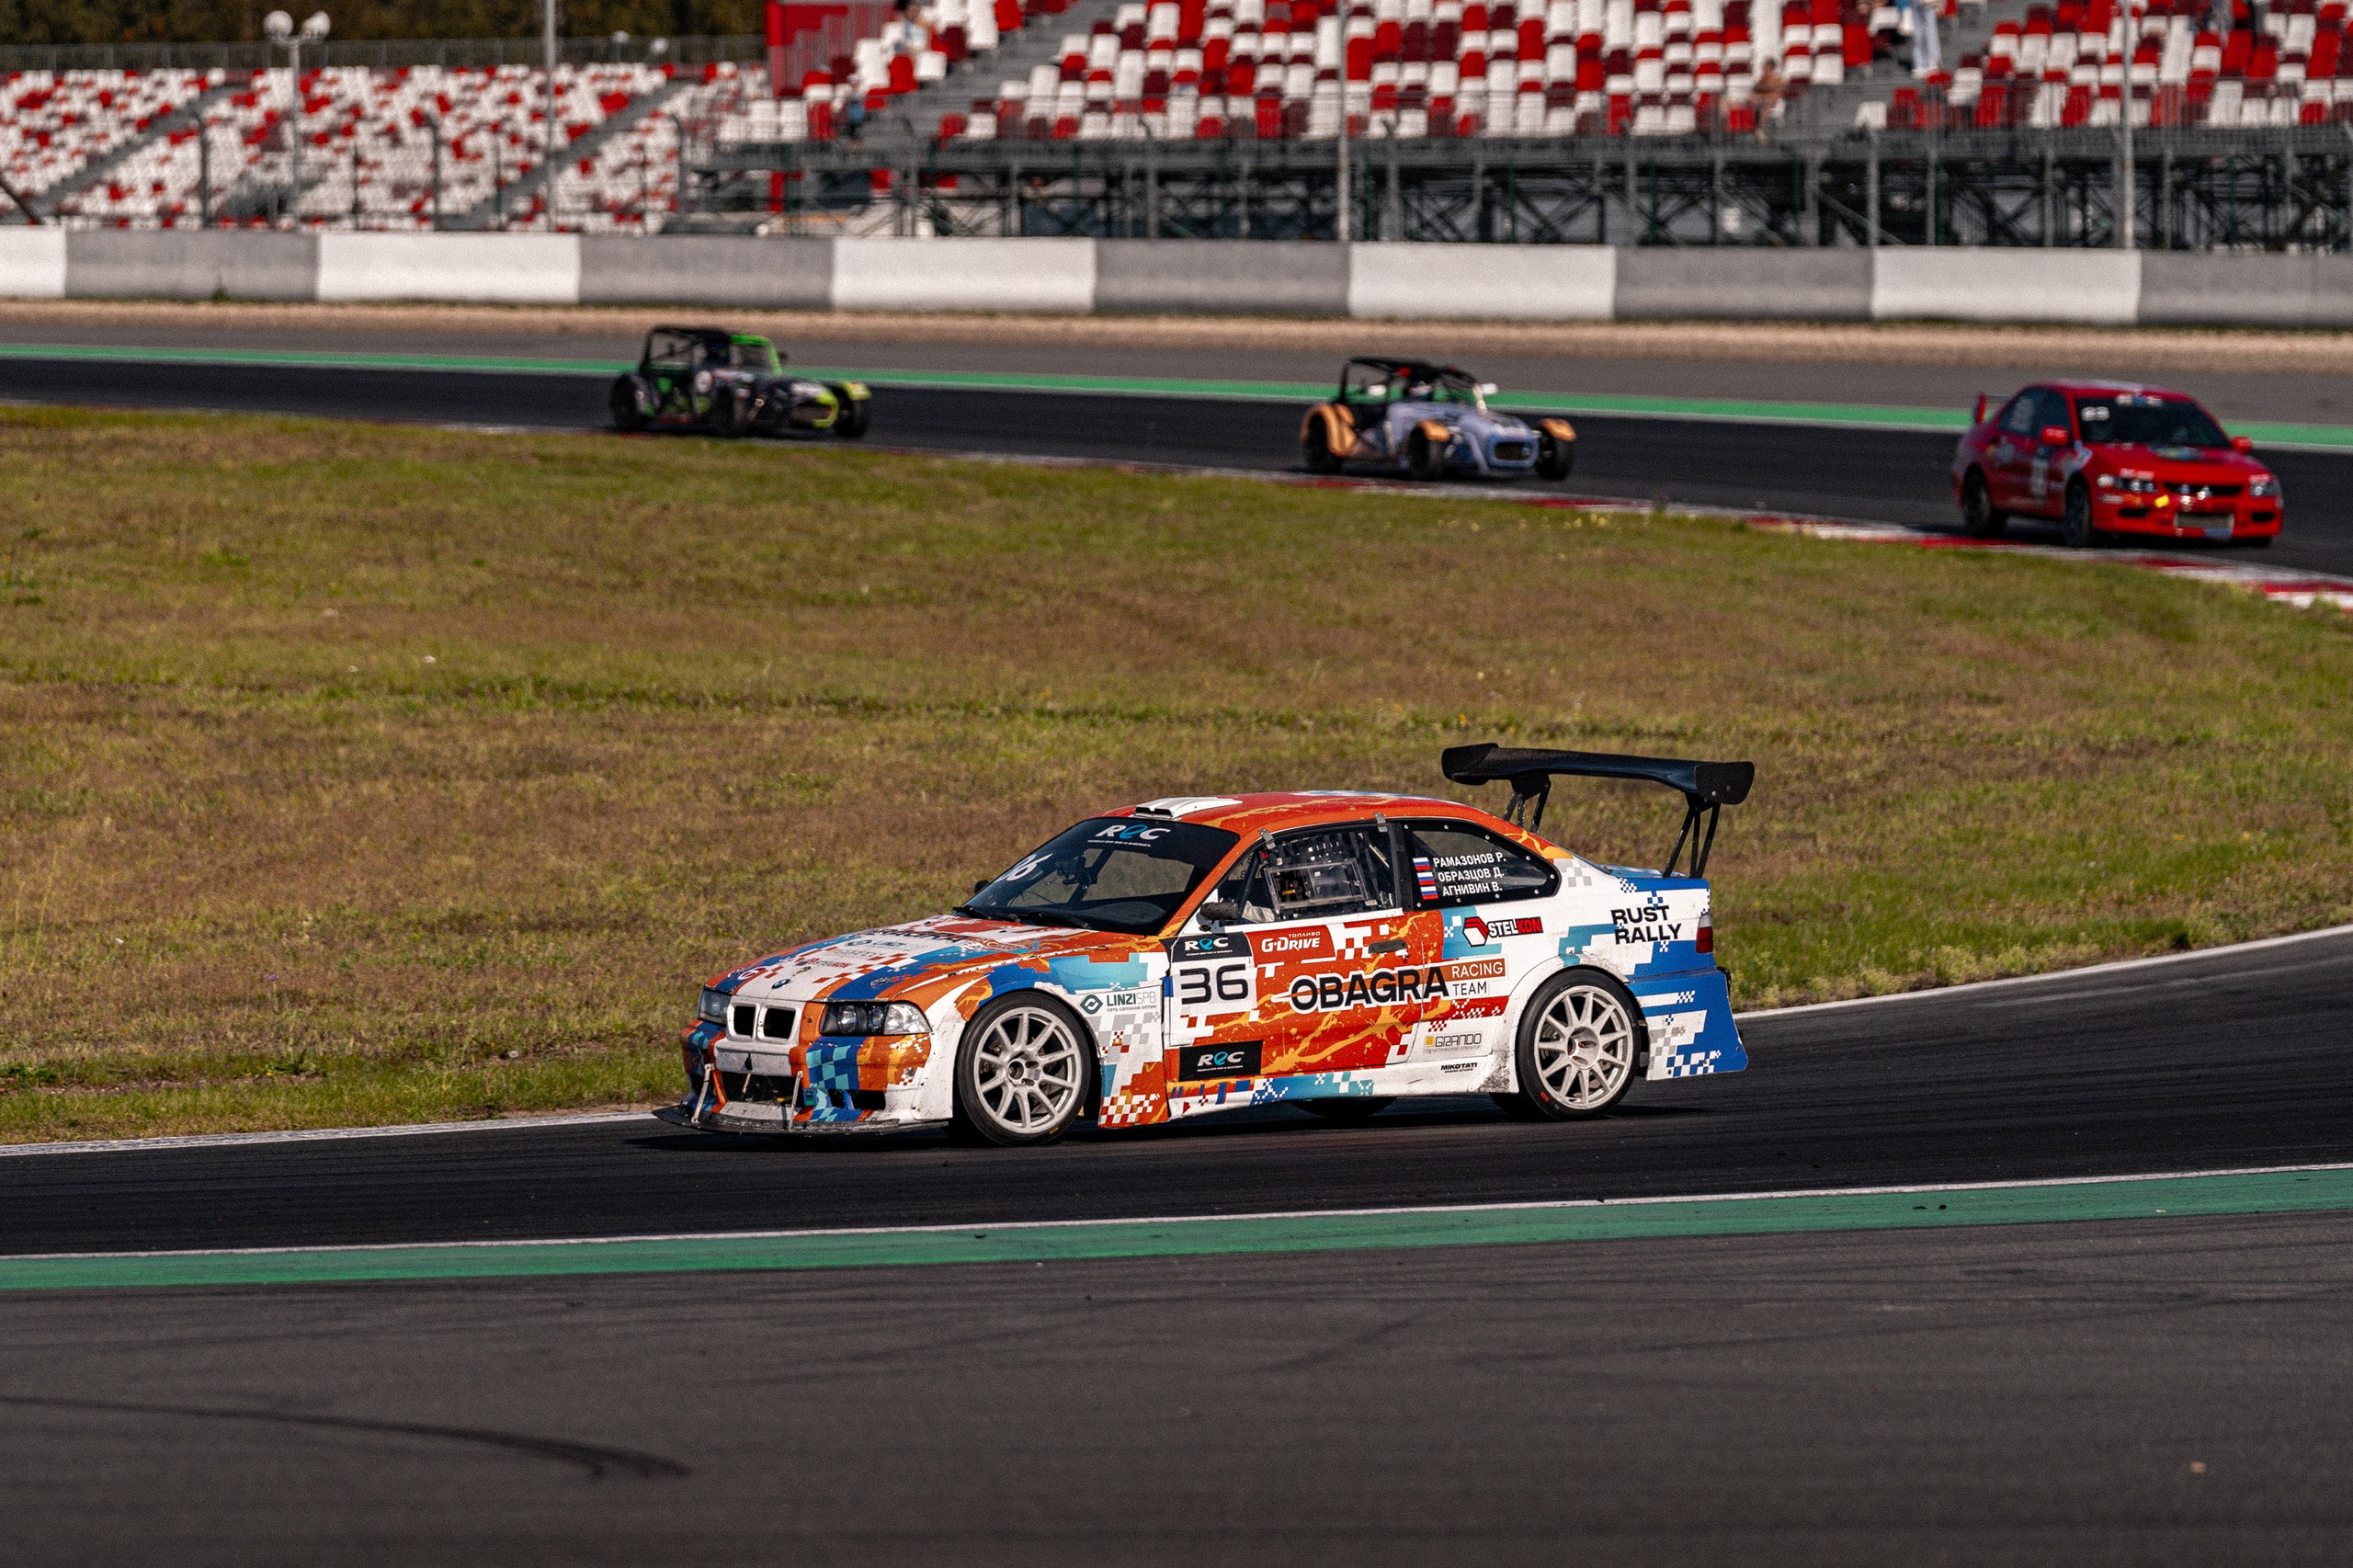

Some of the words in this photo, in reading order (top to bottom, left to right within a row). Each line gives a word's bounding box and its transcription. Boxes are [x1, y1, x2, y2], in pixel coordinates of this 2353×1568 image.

[1433, 853, 1495, 868] РАМАЗОНОВ
[1495, 852, 1507, 862] Р.
[1438, 868, 1492, 882] ОБРАЗЦОВ
[1493, 867, 1506, 879] Д.
[1442, 882, 1490, 896] АГНИВИН
[1491, 881, 1503, 892] В.
[1610, 904, 1670, 924] RUST
[1487, 916, 1543, 938] STELKON
[1614, 923, 1682, 945] RALLY
[1451, 961, 1504, 979] RACING
[1179, 963, 1249, 1005] 36
[1290, 966, 1449, 1011] OBAGRA
[1452, 981, 1488, 996] TEAM
[1441, 1062, 1478, 1071] MIKOTATI
